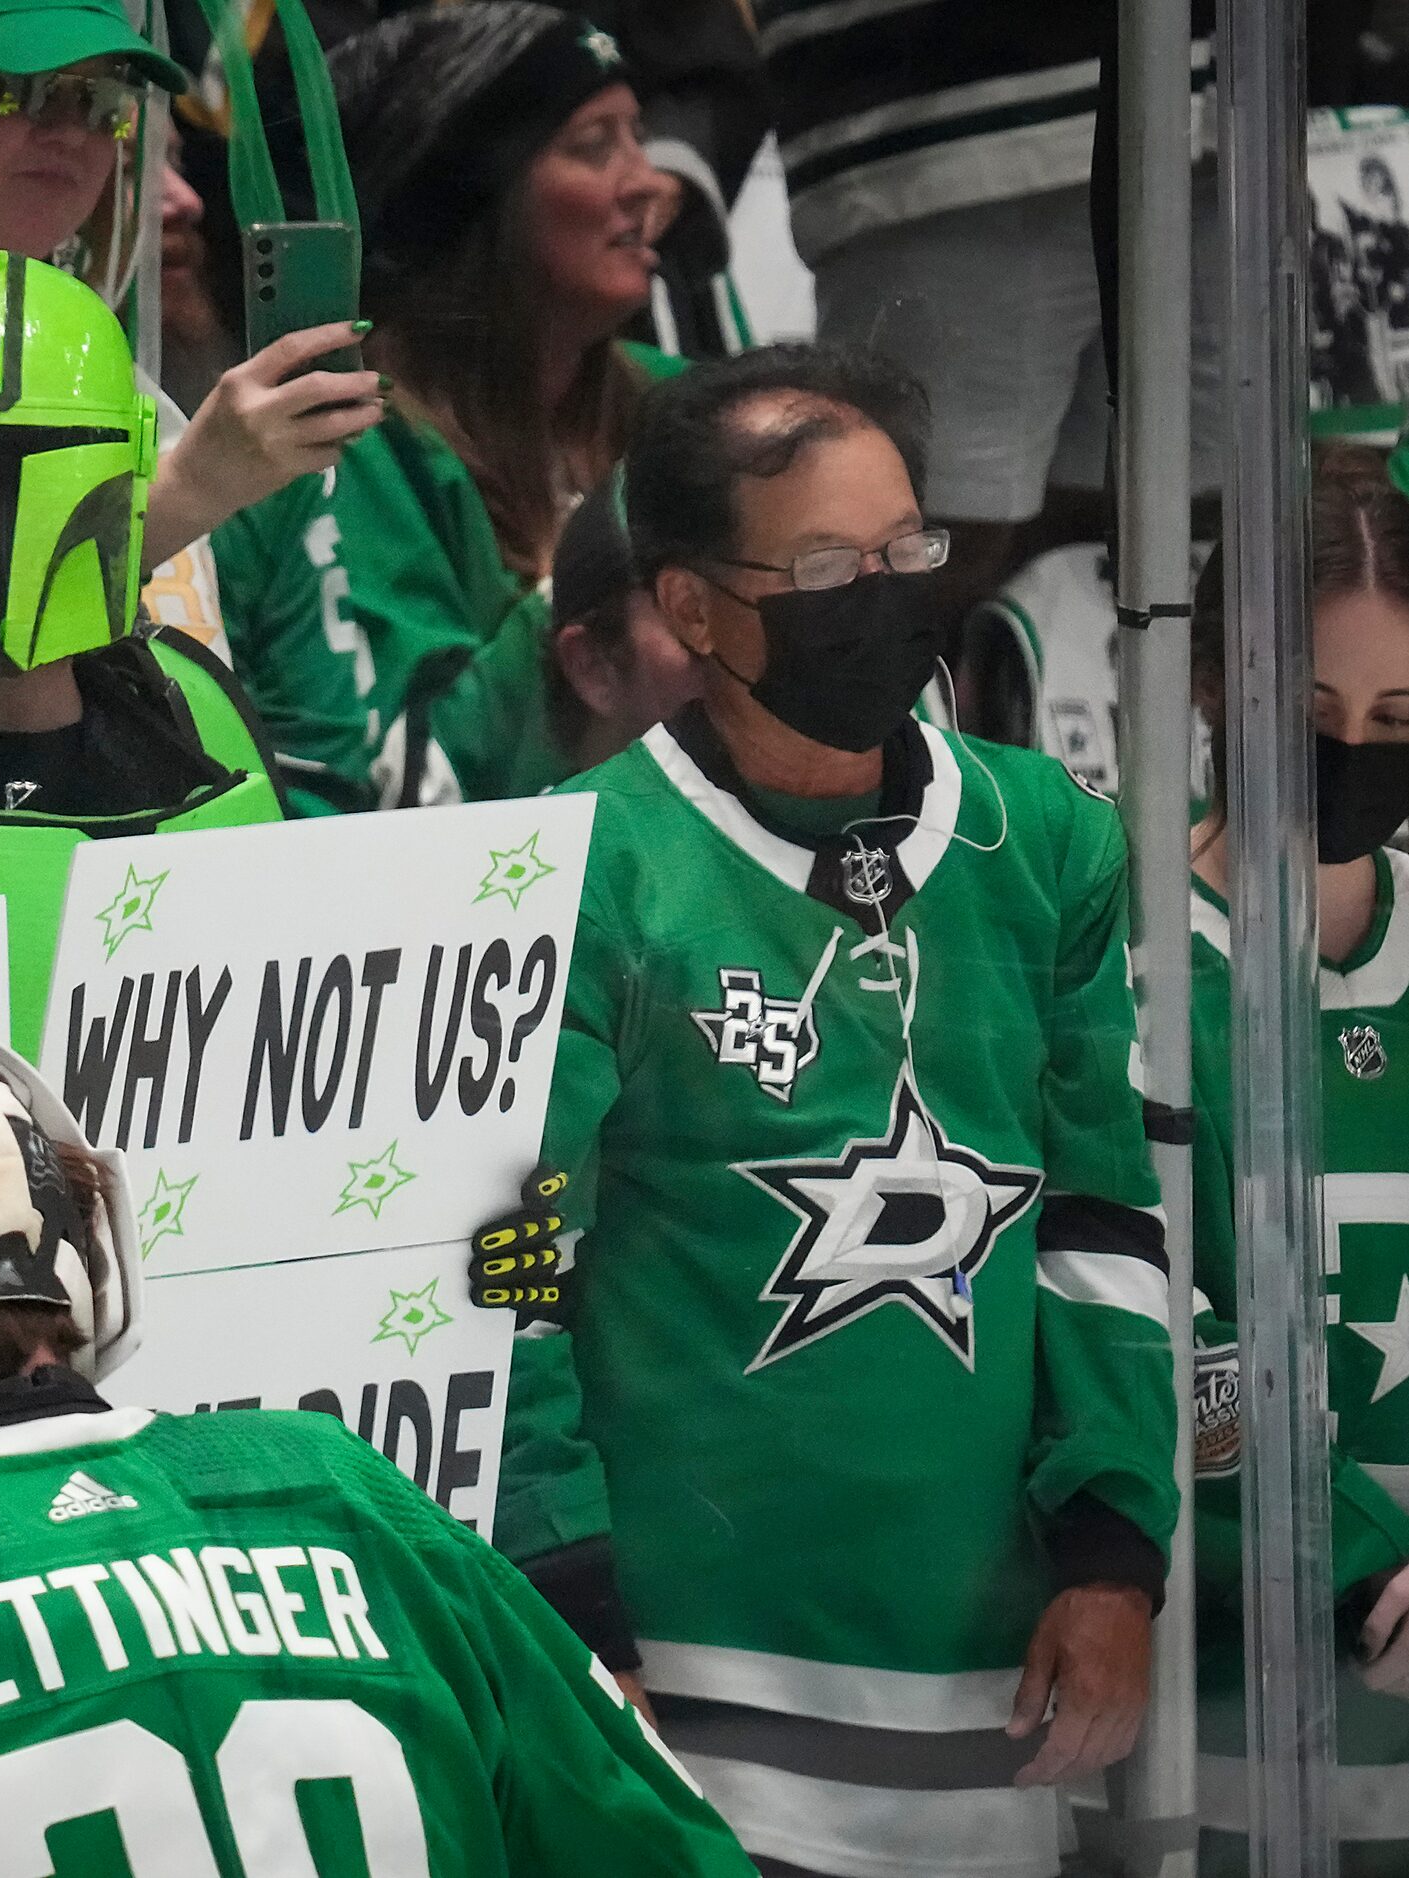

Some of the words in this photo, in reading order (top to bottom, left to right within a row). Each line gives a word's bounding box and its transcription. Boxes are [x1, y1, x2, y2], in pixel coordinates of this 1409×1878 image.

[63, 965, 232, 1152] WHY
[240, 948, 401, 1140] NOT
[415, 935, 556, 1121] US?
[48, 1495, 139, 1521] adidas
